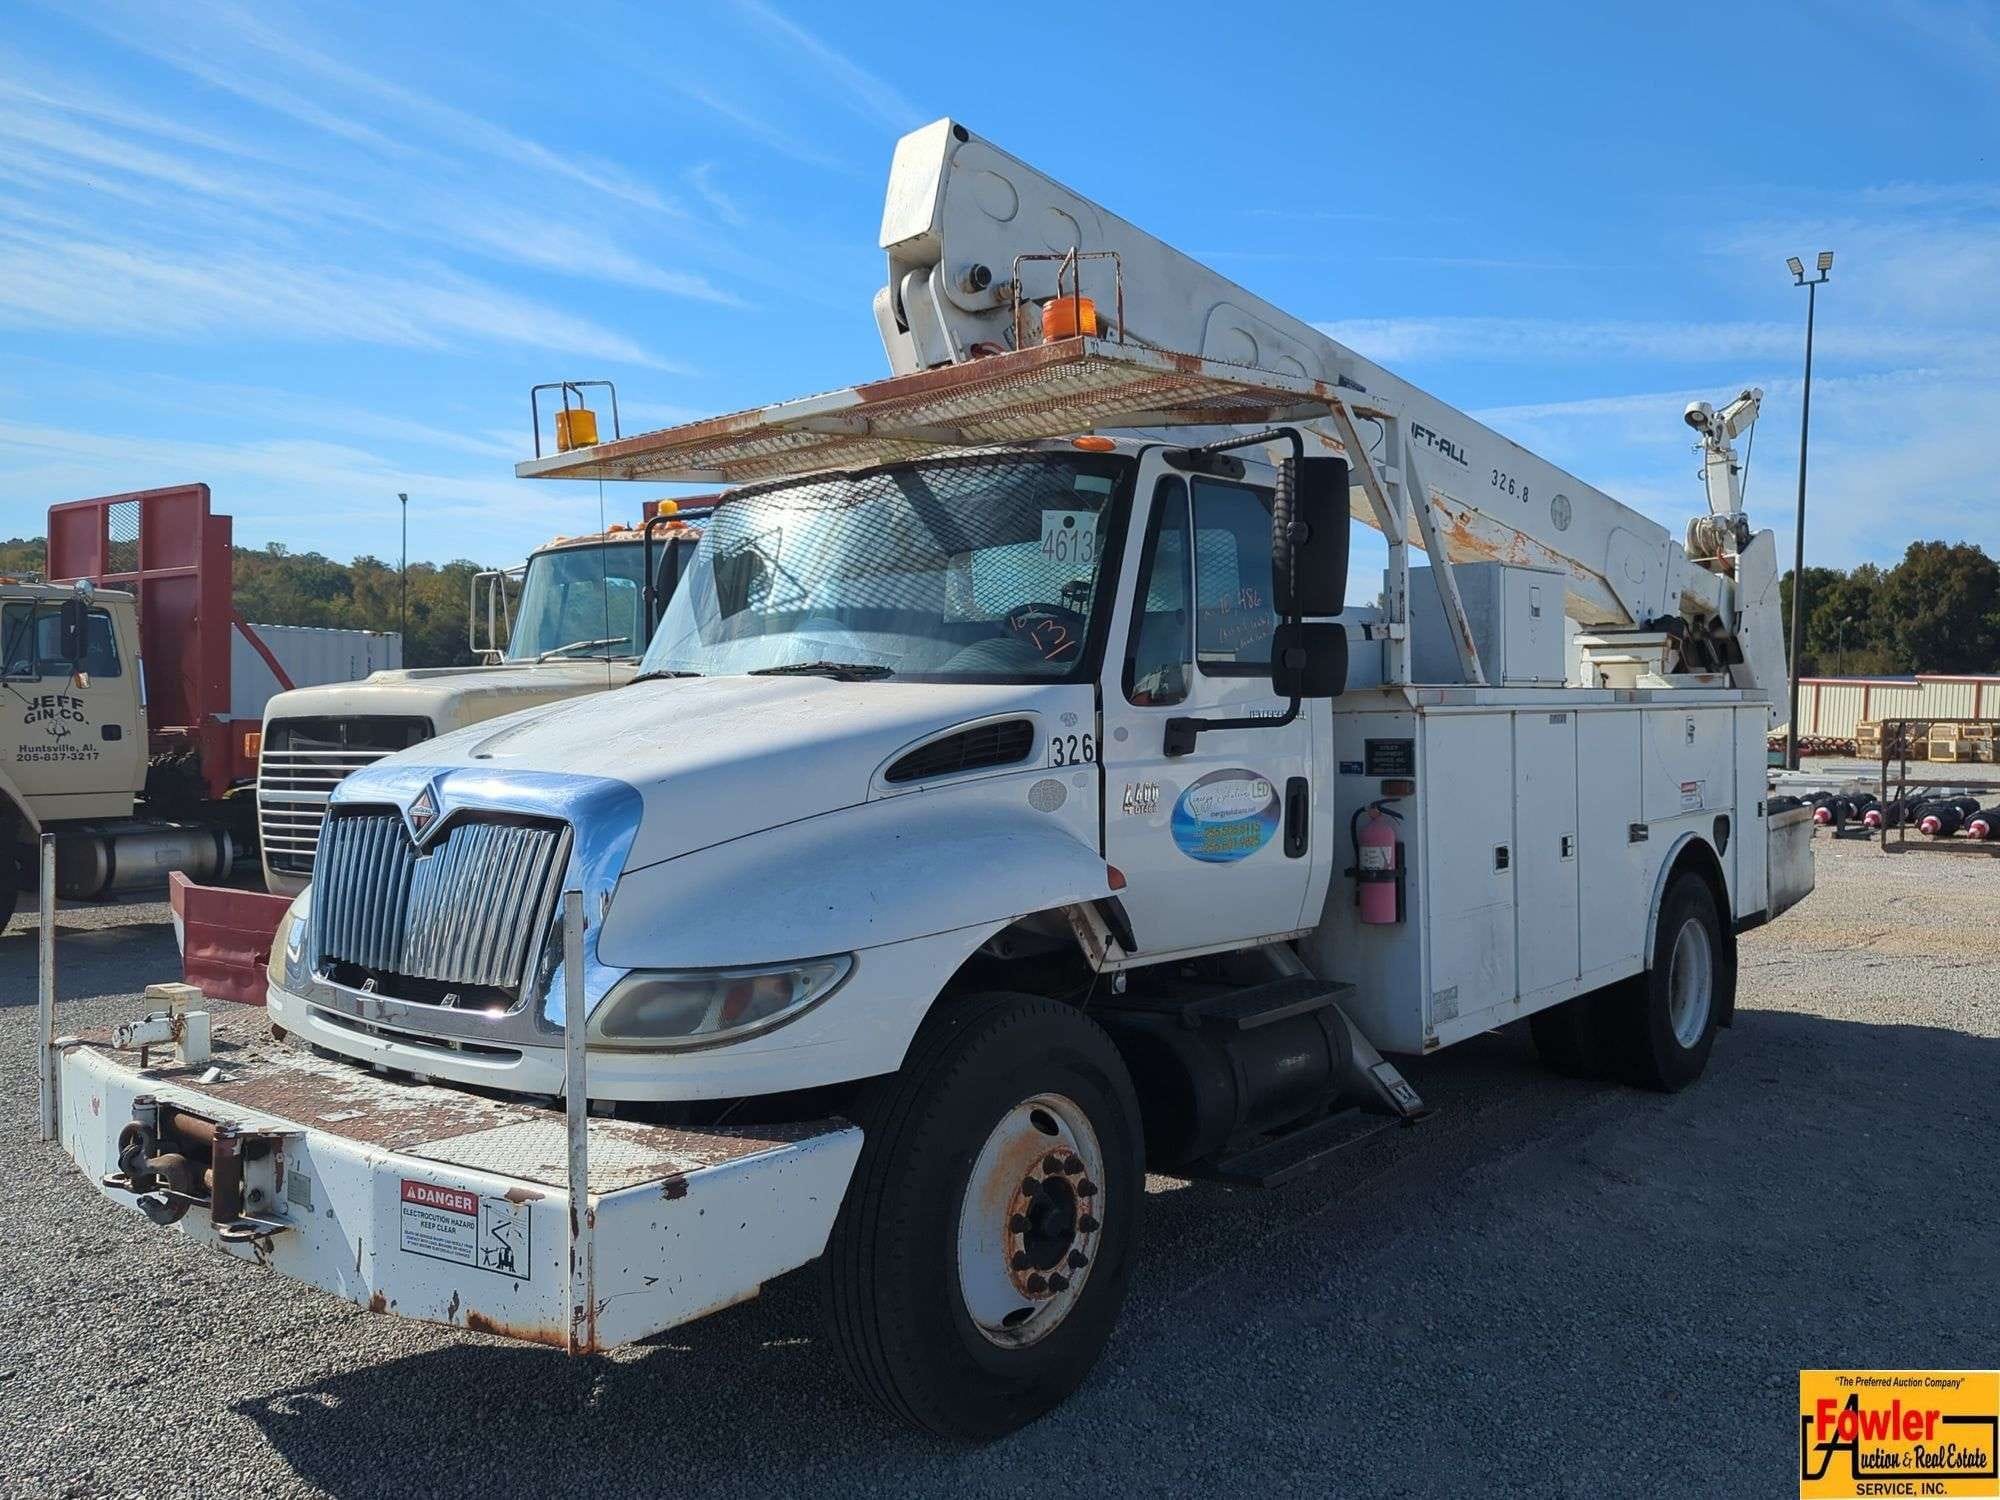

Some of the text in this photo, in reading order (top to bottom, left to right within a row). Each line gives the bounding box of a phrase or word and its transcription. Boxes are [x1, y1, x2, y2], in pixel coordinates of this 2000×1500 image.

[1411, 422, 1468, 466] IFT-ALL
[1491, 469, 1529, 503] 326.8
[1042, 530, 1094, 562] 4613
[27, 695, 84, 711] JEFF
[24, 708, 89, 725] GIN CO.
[16, 752, 100, 762] 205-837-3217
[19, 744, 79, 753] Huntsville,
[1052, 733, 1094, 767] 326
[418, 1188, 472, 1211] DANGER
[403, 1207, 475, 1230] ELECTROCUTION HAZARD
[420, 1221, 456, 1234] KEEP CLEAR
